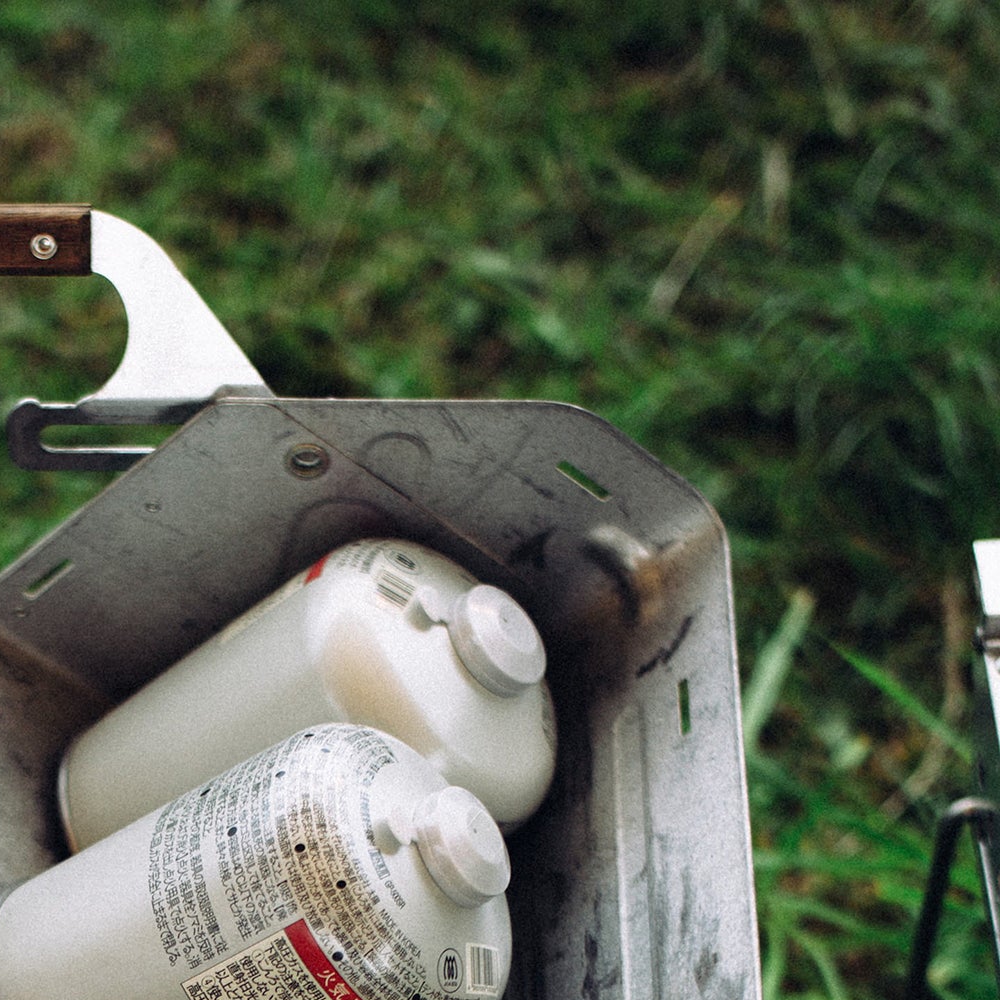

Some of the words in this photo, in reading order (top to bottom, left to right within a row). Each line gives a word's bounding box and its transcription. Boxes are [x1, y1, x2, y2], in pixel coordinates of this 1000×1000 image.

[378, 907, 397, 931] MADE
[394, 928, 404, 938] IN
[401, 935, 423, 959] KOREA
